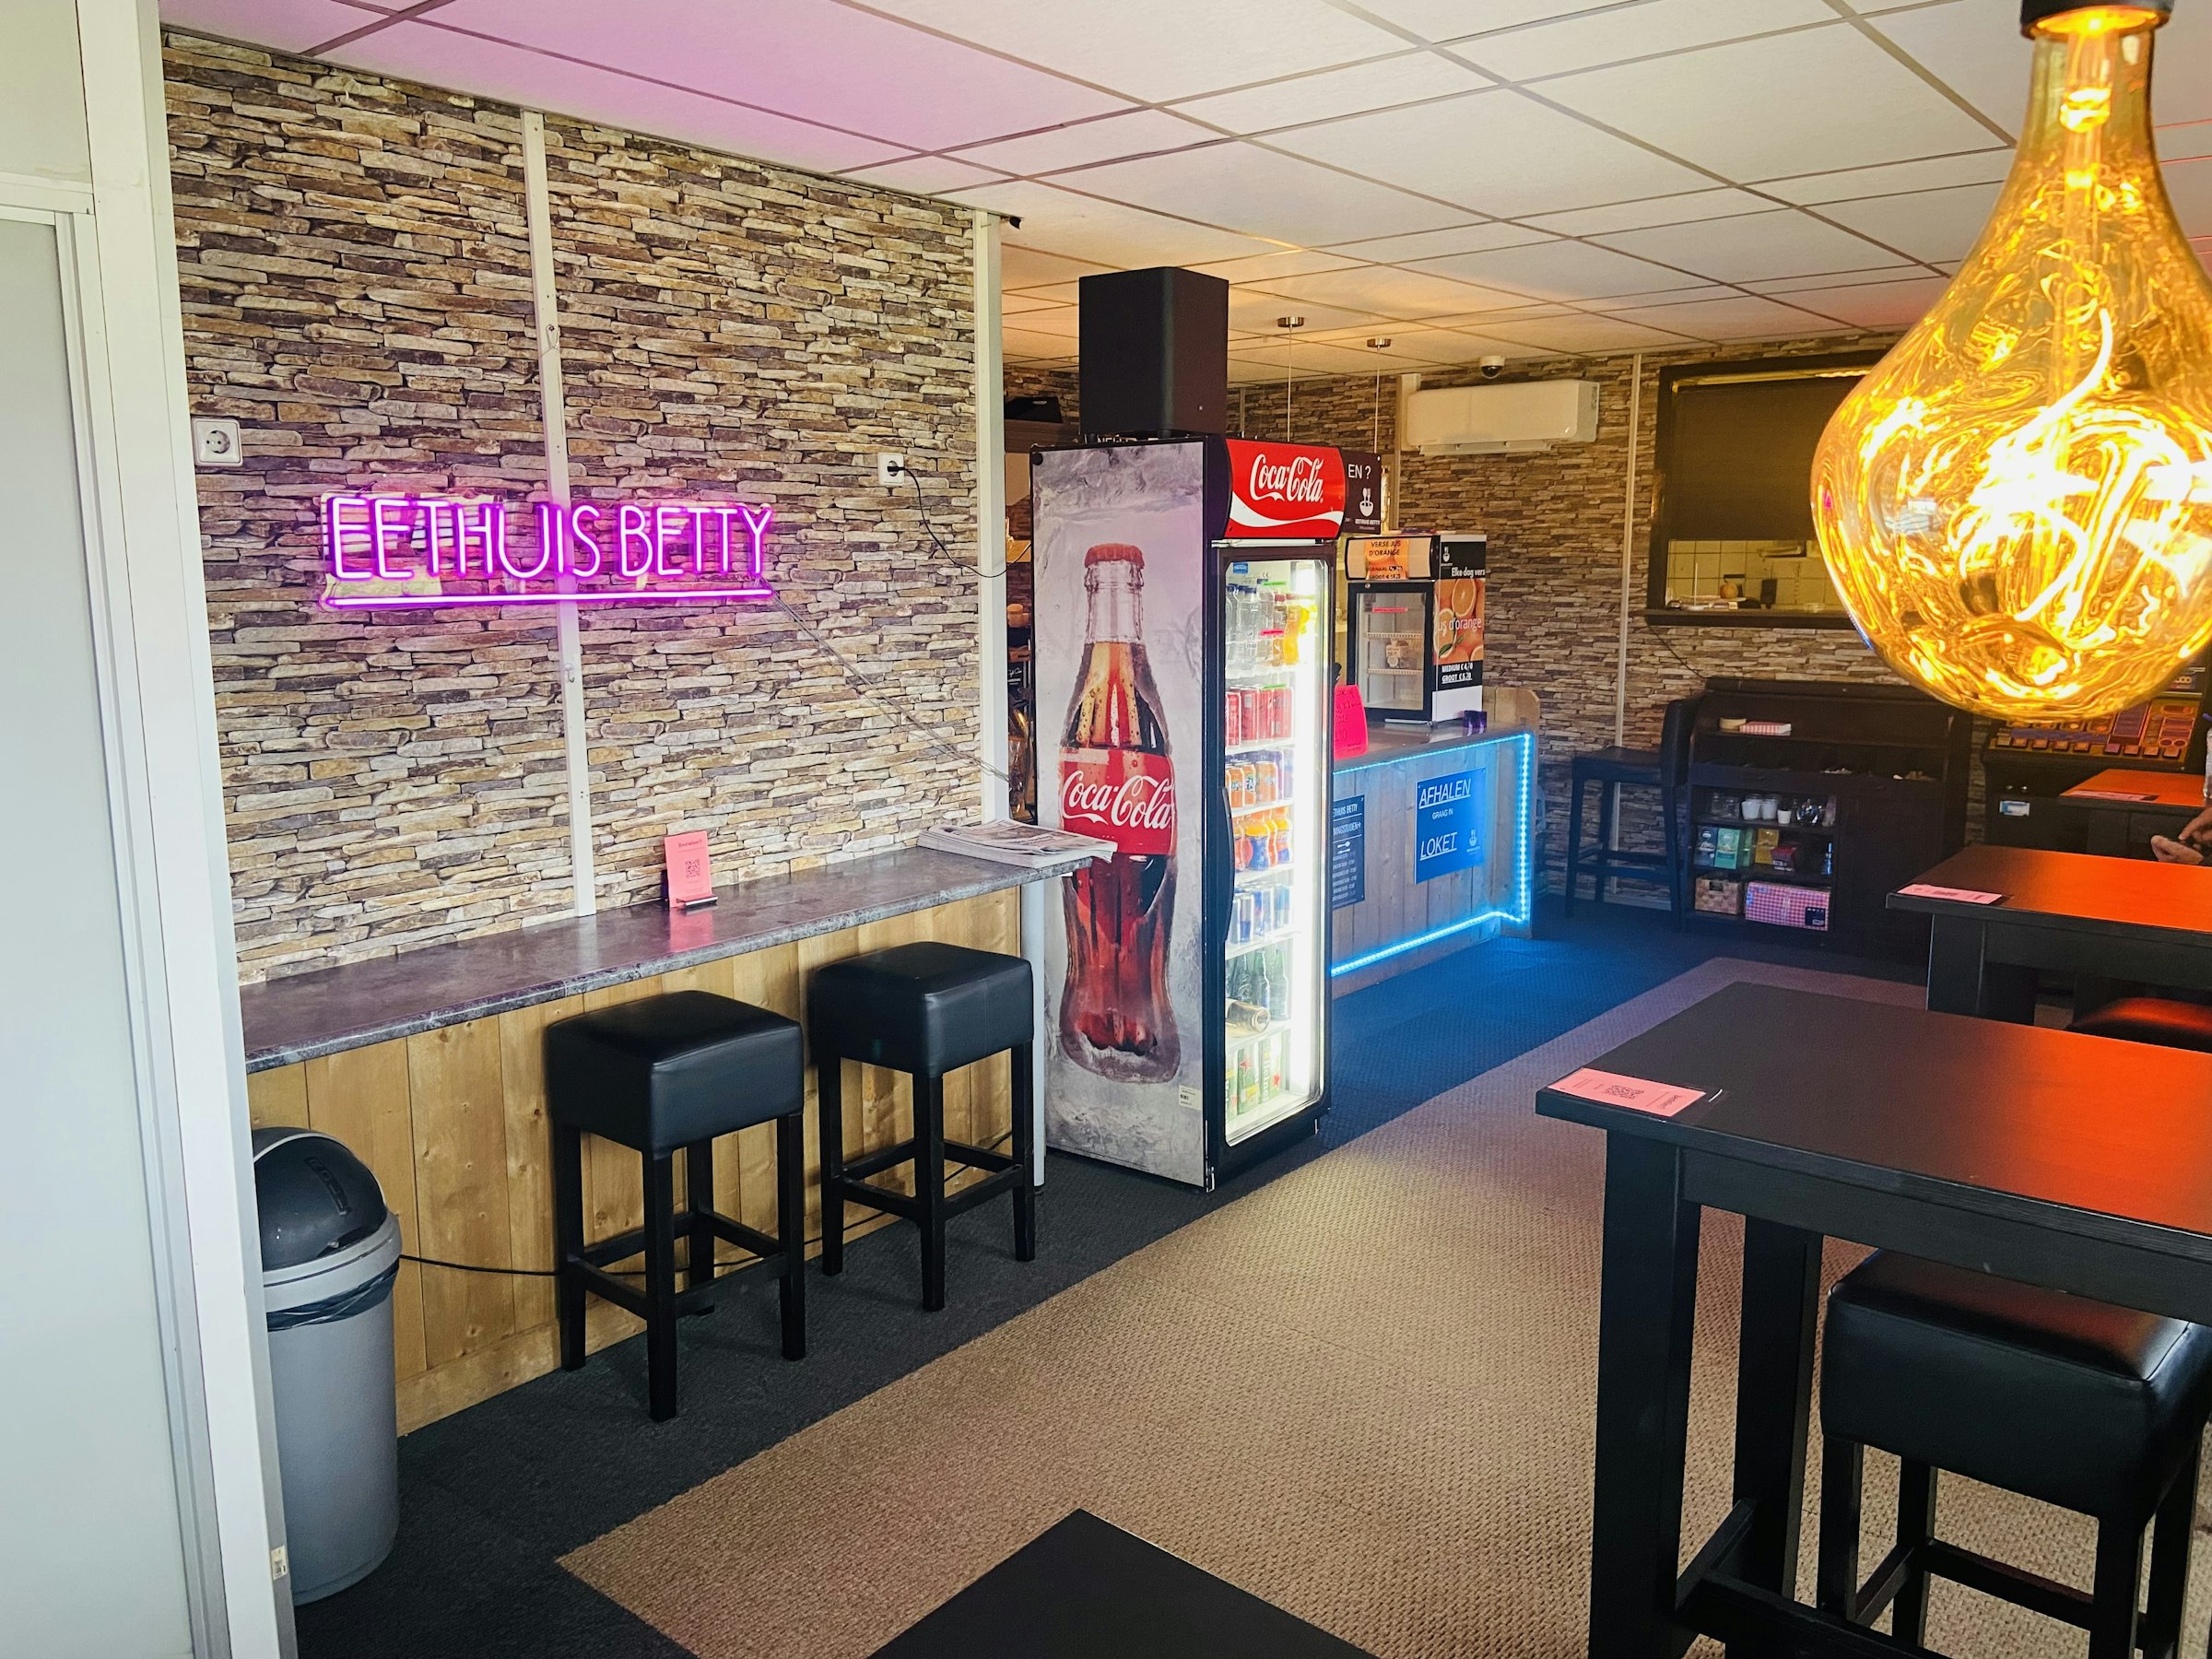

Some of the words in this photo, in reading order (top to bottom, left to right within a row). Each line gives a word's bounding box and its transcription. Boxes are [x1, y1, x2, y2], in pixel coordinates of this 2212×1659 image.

[1250, 453, 1324, 502] Coca-Cola
[1347, 464, 1362, 478] EN
[329, 496, 600, 580] EETHUIS
[618, 502, 773, 579] BETTY
[1063, 770, 1174, 830] Coca-Cola
[1418, 778, 1471, 808] AFHALEN
[1432, 808, 1448, 819] GRAAG
[1420, 832, 1457, 860] LOKET
